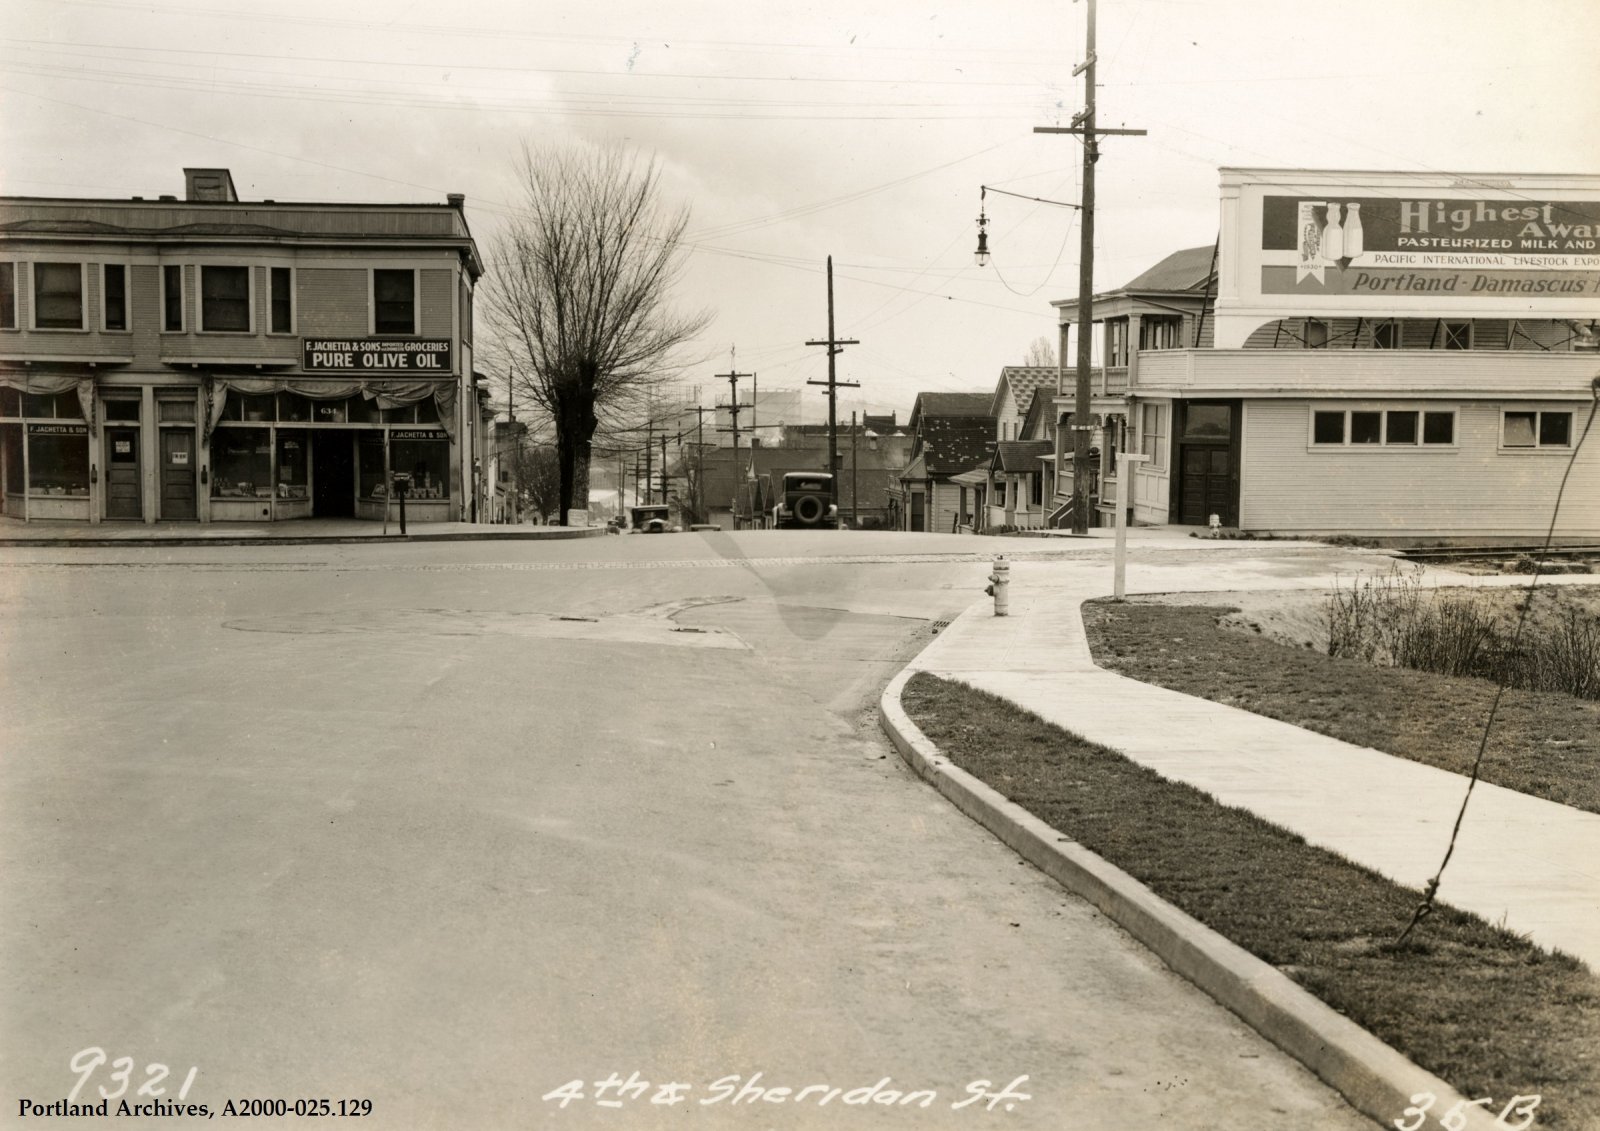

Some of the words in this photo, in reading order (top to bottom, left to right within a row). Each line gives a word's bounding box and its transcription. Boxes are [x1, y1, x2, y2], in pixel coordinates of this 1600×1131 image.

[1400, 201, 1554, 233] Highest
[1398, 238, 1512, 248] PASTEURIZED
[1521, 239, 1558, 249] MILK
[1565, 240, 1595, 249] AND
[1375, 254, 1416, 264] PACIFIC
[1423, 255, 1505, 265] INTERNATIONAL
[1513, 256, 1569, 266] LIVESTOCK
[352, 342, 359, 351] &
[360, 342, 381, 352] SONS
[404, 343, 449, 352] GROCERIES
[312, 352, 354, 367] PURE
[362, 353, 408, 368] OLIVE
[416, 353, 441, 368] OIL
[320, 407, 337, 415] 634
